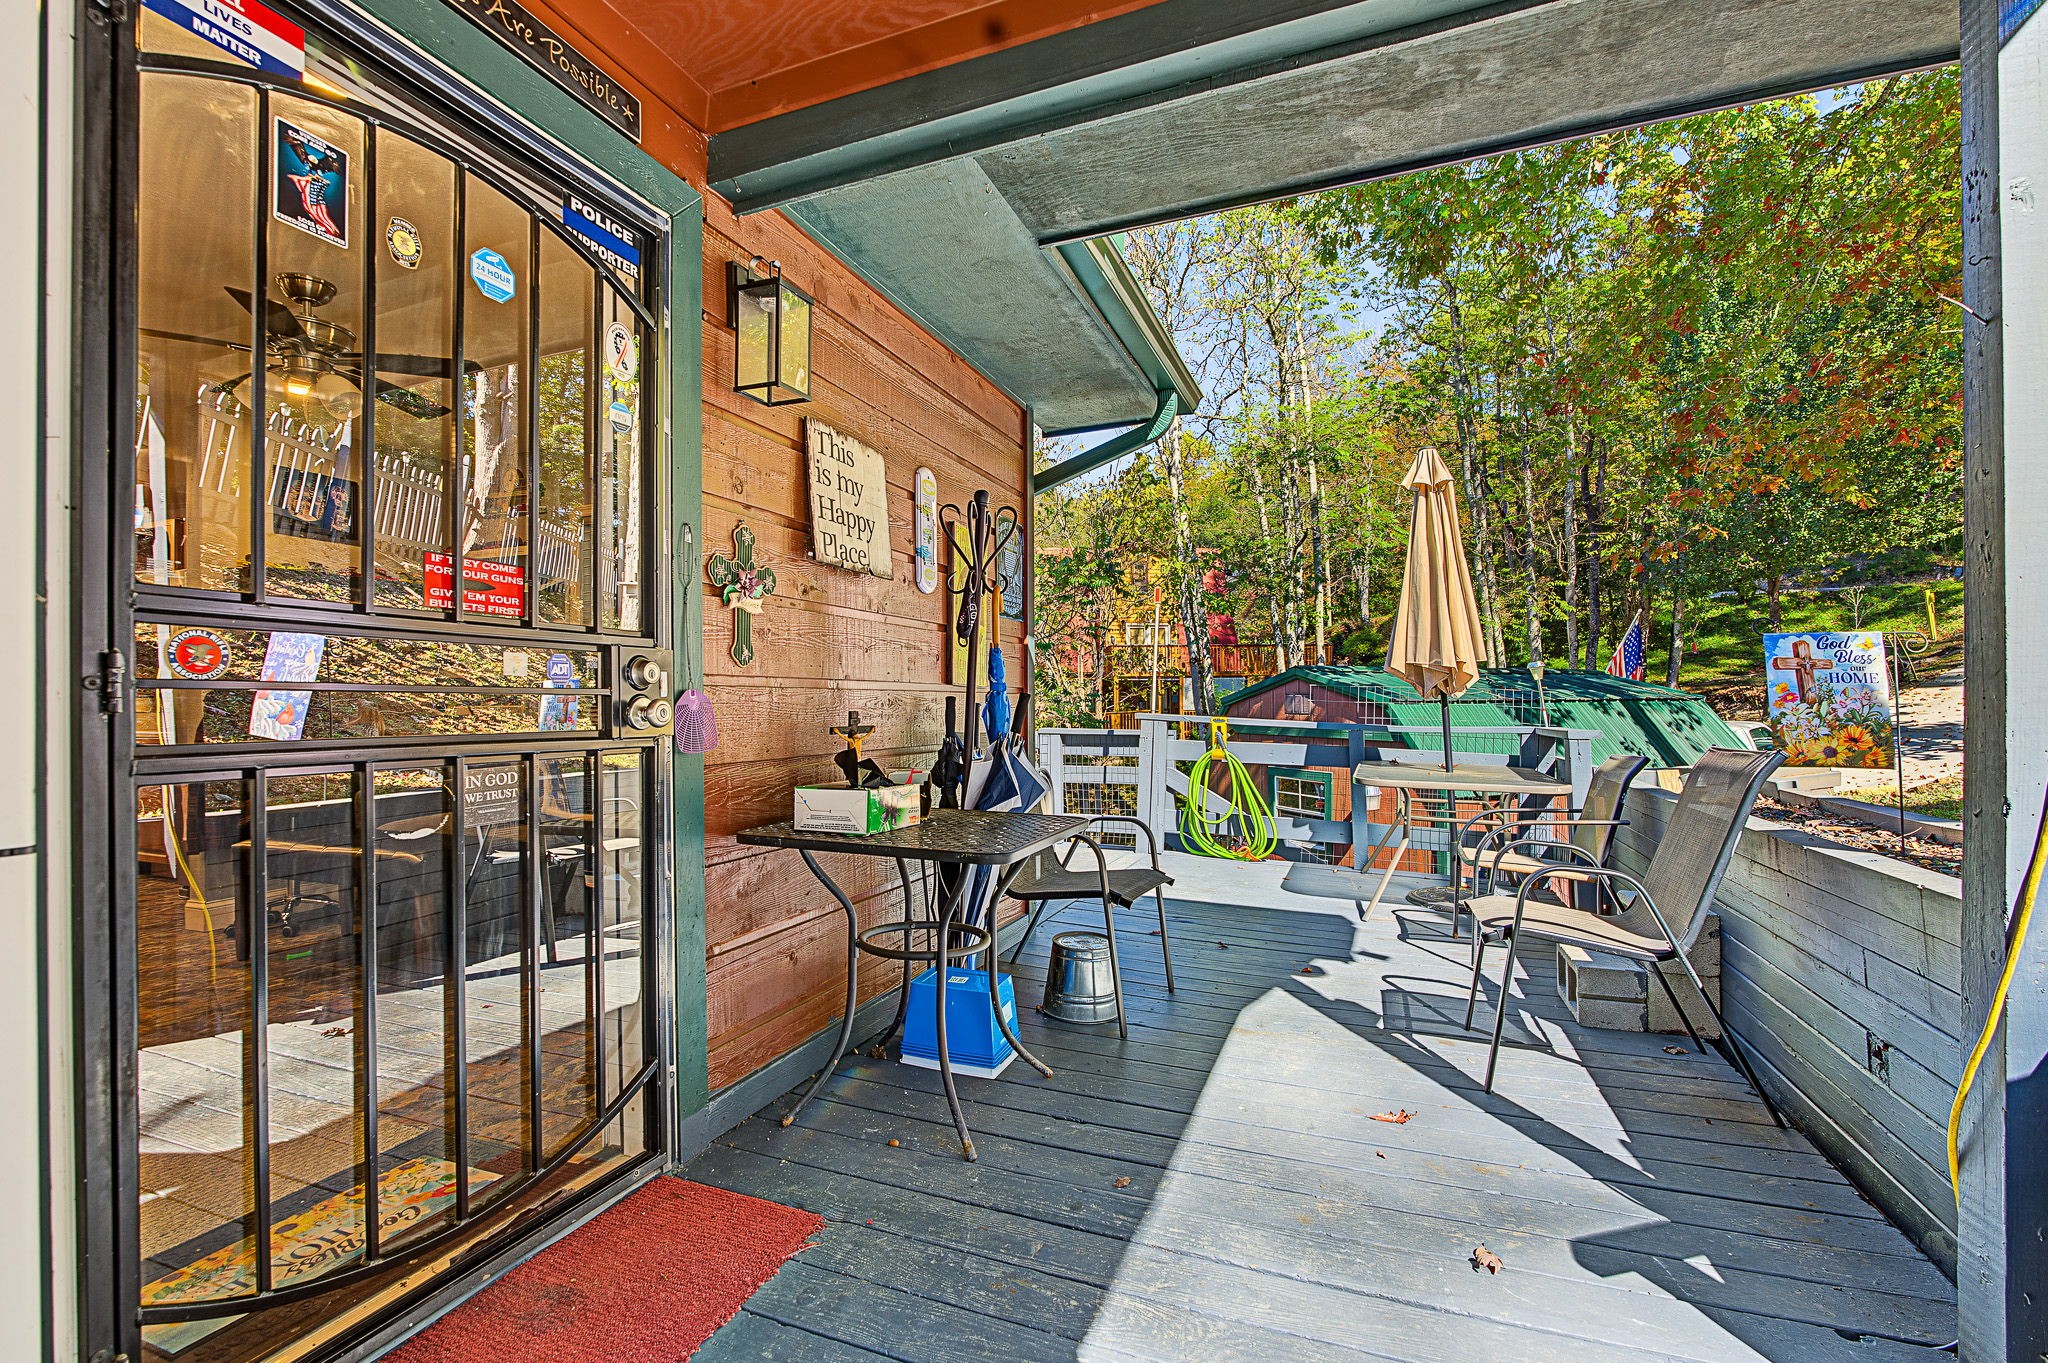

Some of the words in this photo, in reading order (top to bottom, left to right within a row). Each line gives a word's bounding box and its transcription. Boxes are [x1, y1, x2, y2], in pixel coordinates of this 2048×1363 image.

[204, 0, 253, 36] LIVES
[192, 16, 262, 66] MATTER
[484, 0, 535, 45] Are
[540, 38, 619, 110] Possible
[570, 196, 634, 247] POLICE
[565, 225, 639, 279] PPORTER
[476, 262, 486, 272] 24
[487, 268, 511, 285] HOUR
[814, 428, 855, 468] This
[816, 459, 831, 487] is
[837, 470, 864, 507] my
[816, 493, 876, 543] Happy
[820, 530, 869, 567] Place
[431, 553, 445, 563] IF
[446, 555, 480, 568] TEY
[482, 562, 517, 574] COME
[490, 574, 524, 586] GUNS
[429, 587, 453, 597] GIV
[488, 595, 519, 606] YOUR
[429, 599, 486, 612] BULETS
[487, 606, 521, 616] FIRST
[167, 630, 210, 654] NATIONAL
[209, 634, 229, 656] RIFLE
[1816, 635, 1850, 650] God
[1834, 650, 1877, 664] Bless
[169, 662, 227, 680] ASSOCIATION
[551, 663, 569, 676] ADT
[1828, 672, 1879, 684] HOME
[465, 773, 482, 789] IN
[485, 771, 519, 787] GOD
[465, 792, 484, 804] WE
[484, 788, 519, 800] TRUST
[379, 1205, 421, 1232] Go
